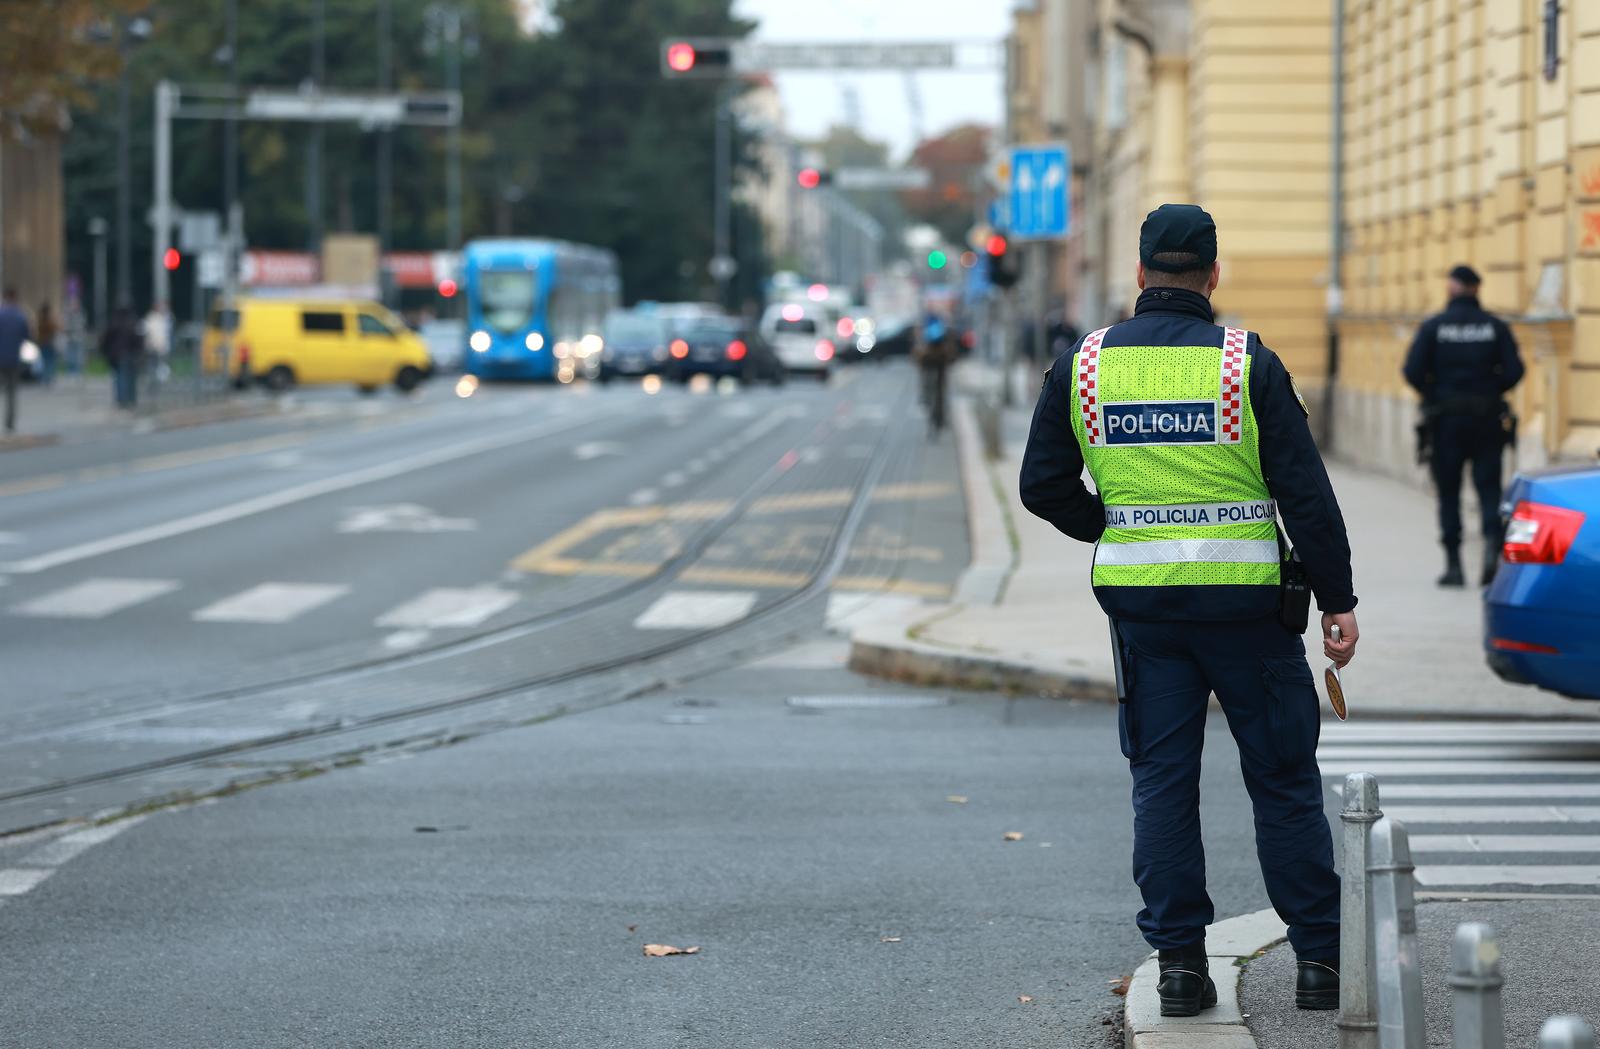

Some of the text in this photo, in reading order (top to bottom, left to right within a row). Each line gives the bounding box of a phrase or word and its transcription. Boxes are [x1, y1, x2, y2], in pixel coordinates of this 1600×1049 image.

[1107, 412, 1210, 434] POLICIJA
[1104, 510, 1127, 525] CIJA
[1133, 508, 1209, 525] POLICIJA
